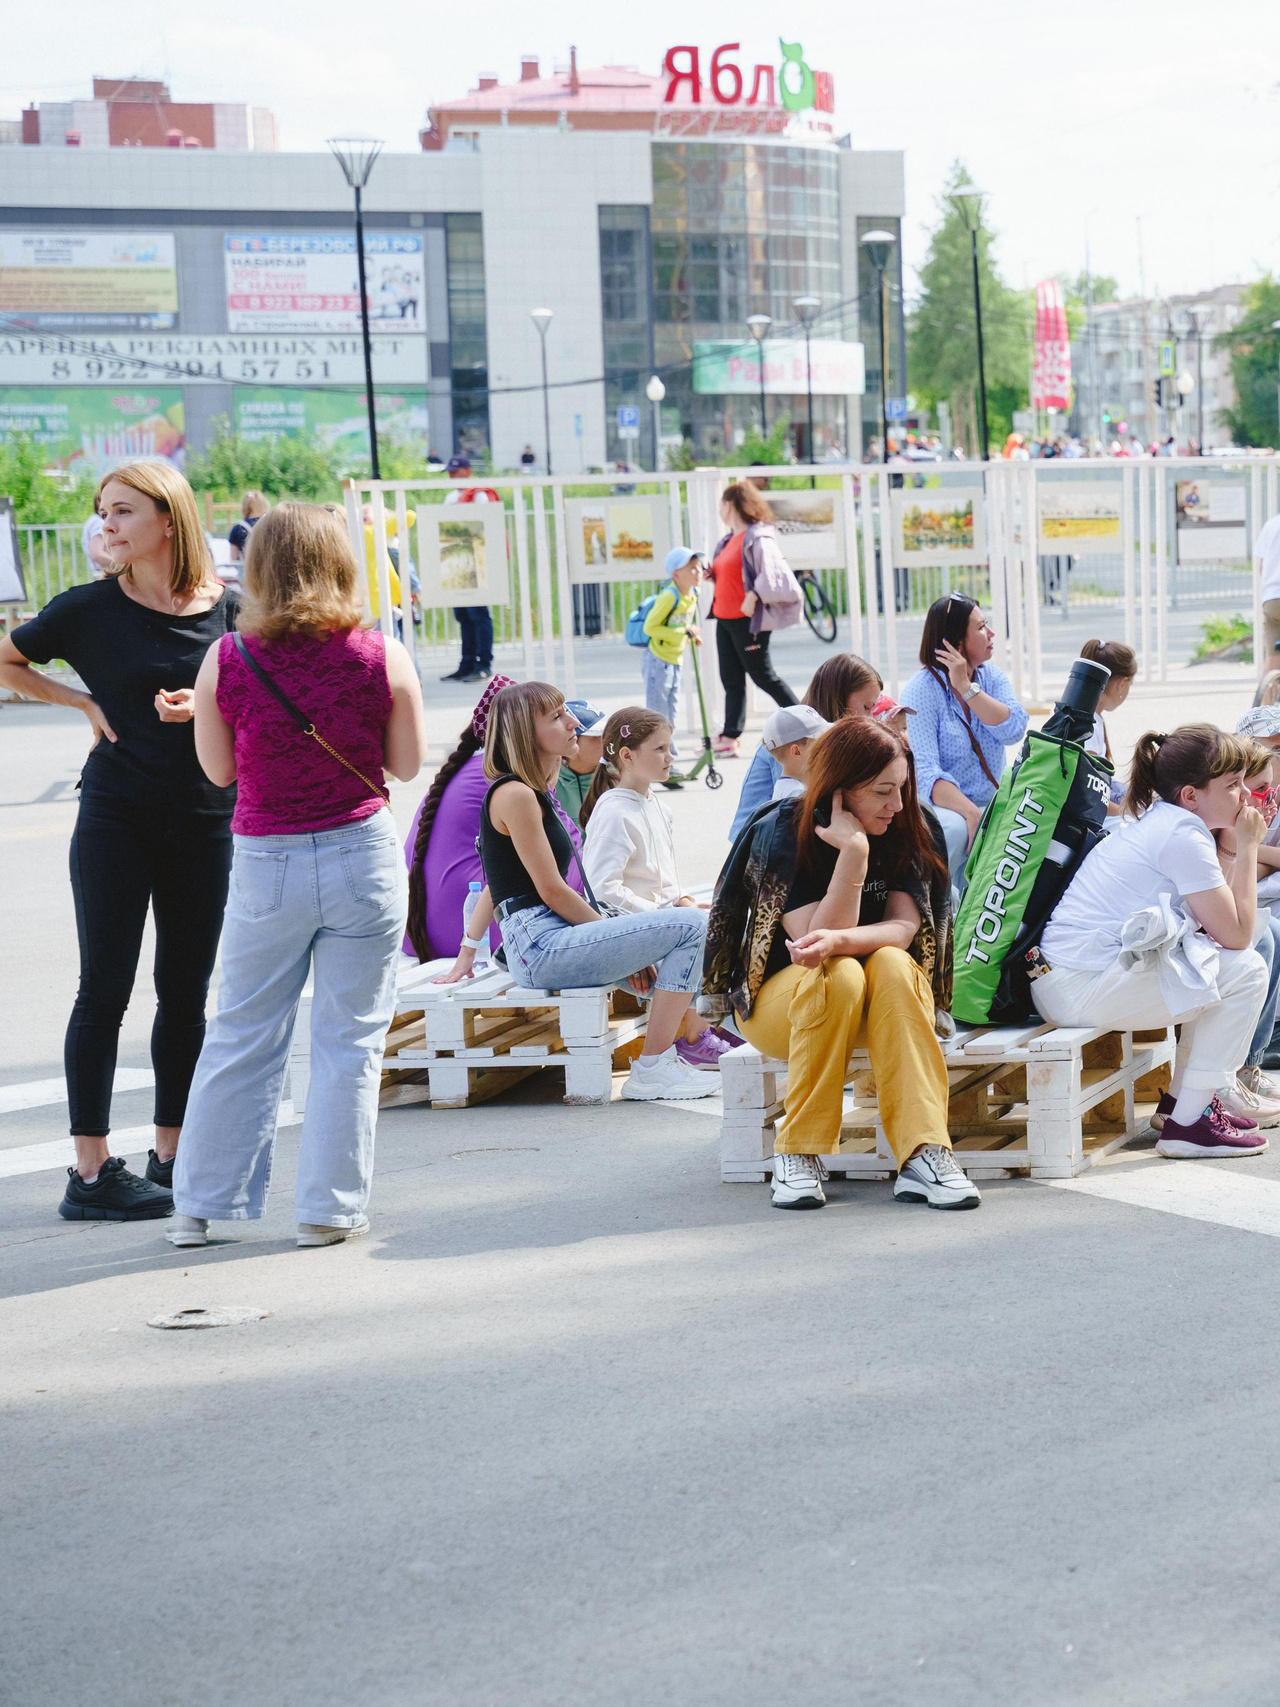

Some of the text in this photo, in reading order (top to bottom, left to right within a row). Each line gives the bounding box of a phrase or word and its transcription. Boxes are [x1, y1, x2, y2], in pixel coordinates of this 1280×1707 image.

[129, 340, 317, 356] РЕКЛАМНЫХ
[52, 359, 71, 380] 8
[86, 359, 149, 380] 922
[963, 787, 1045, 966] TOPOINT
